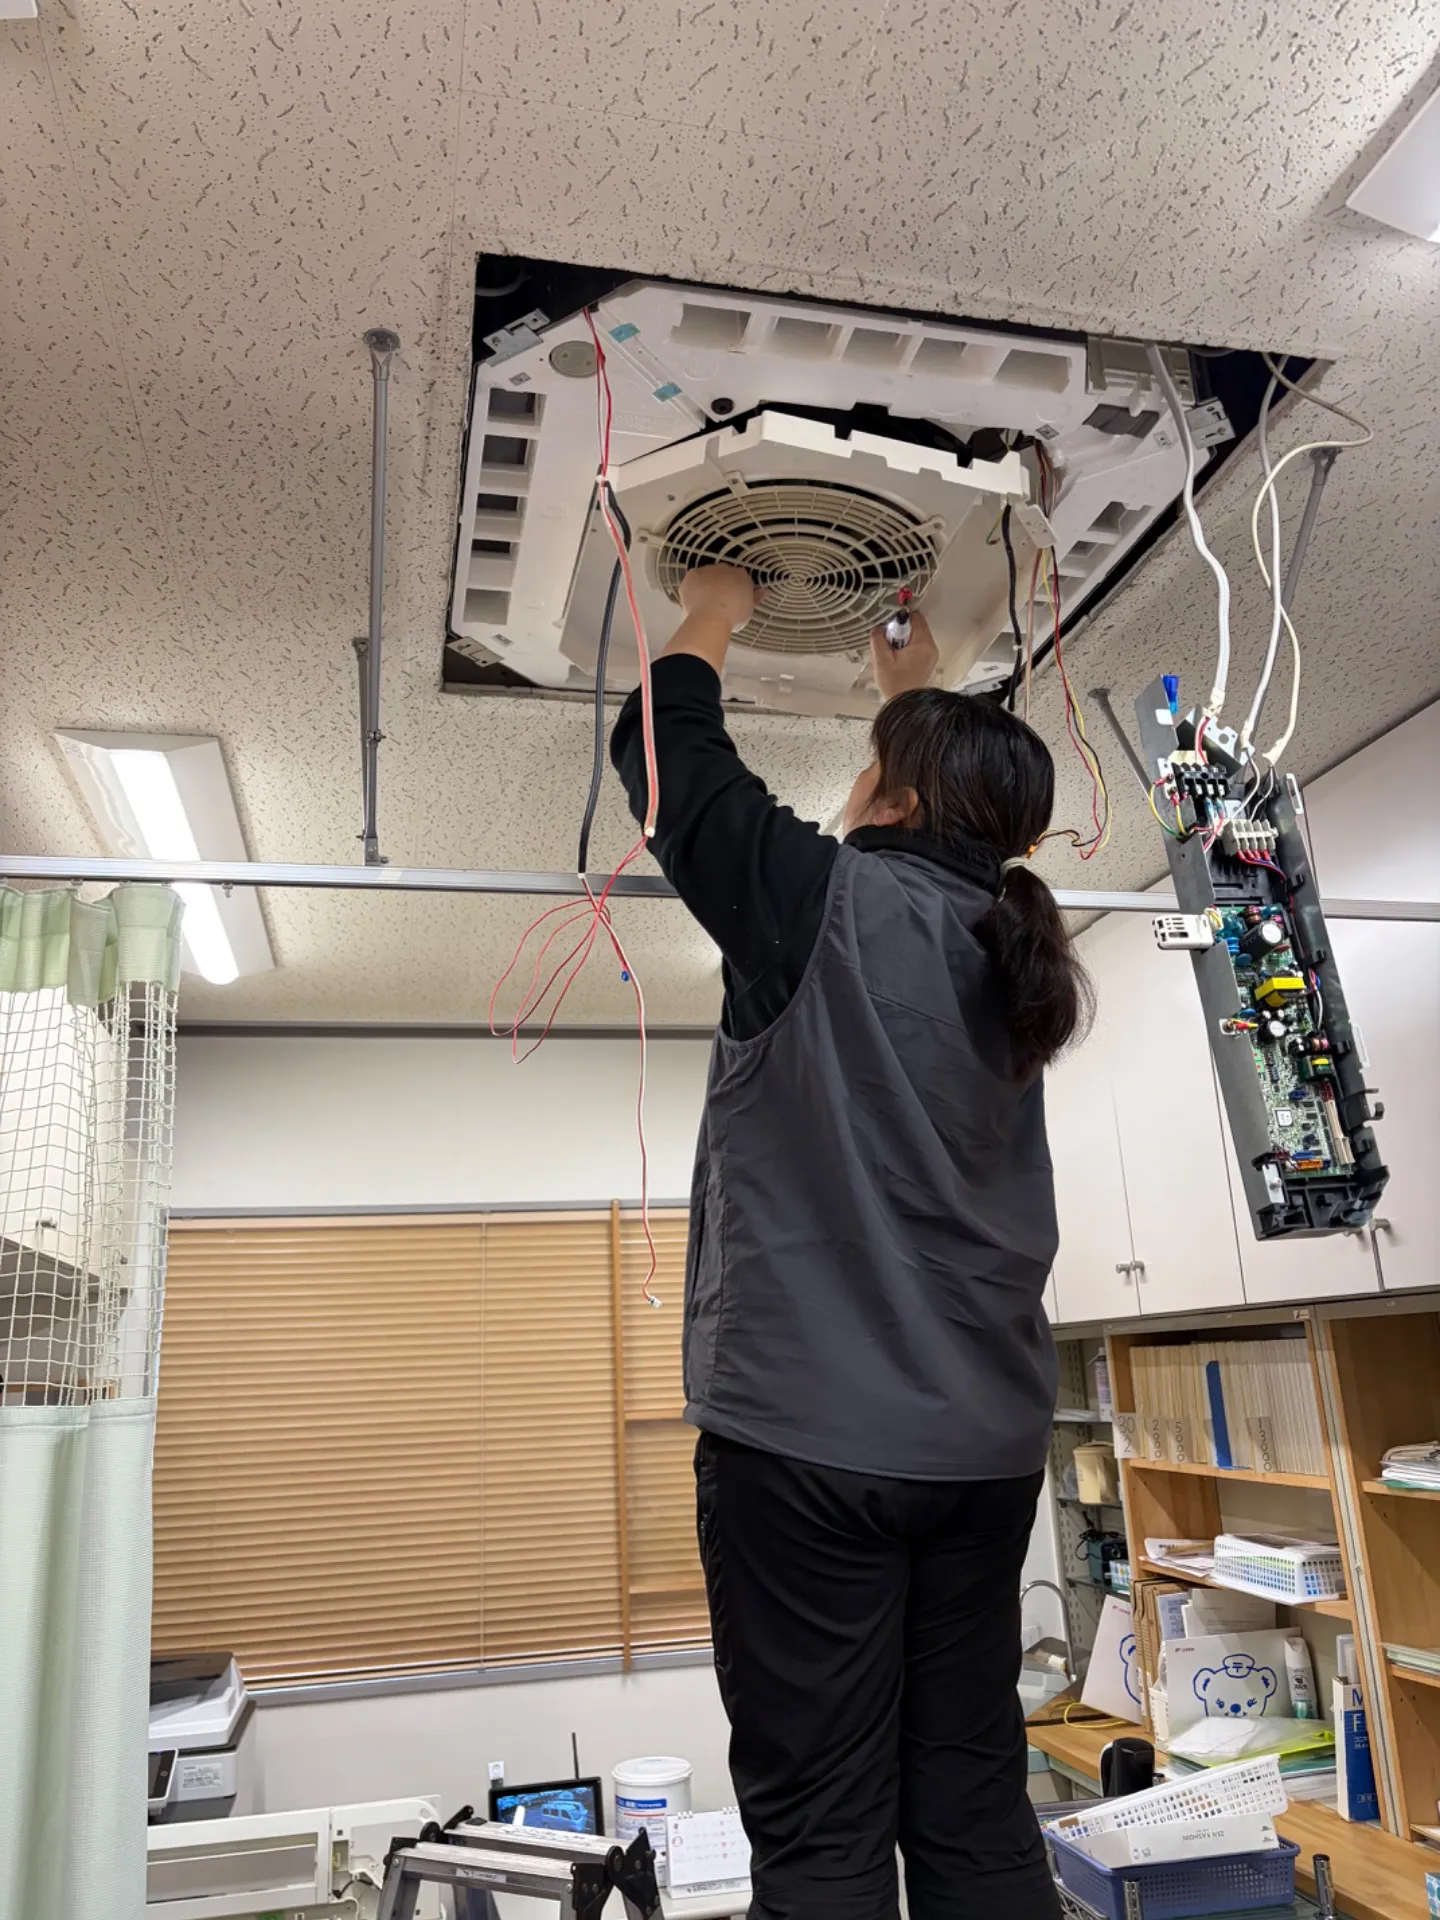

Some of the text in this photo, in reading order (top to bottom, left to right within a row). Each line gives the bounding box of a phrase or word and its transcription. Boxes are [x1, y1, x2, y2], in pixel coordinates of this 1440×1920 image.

[1151, 1419, 1162, 1459] 2000
[1175, 1421, 1186, 1462] 5000
[1257, 1418, 1272, 1471] 13000
